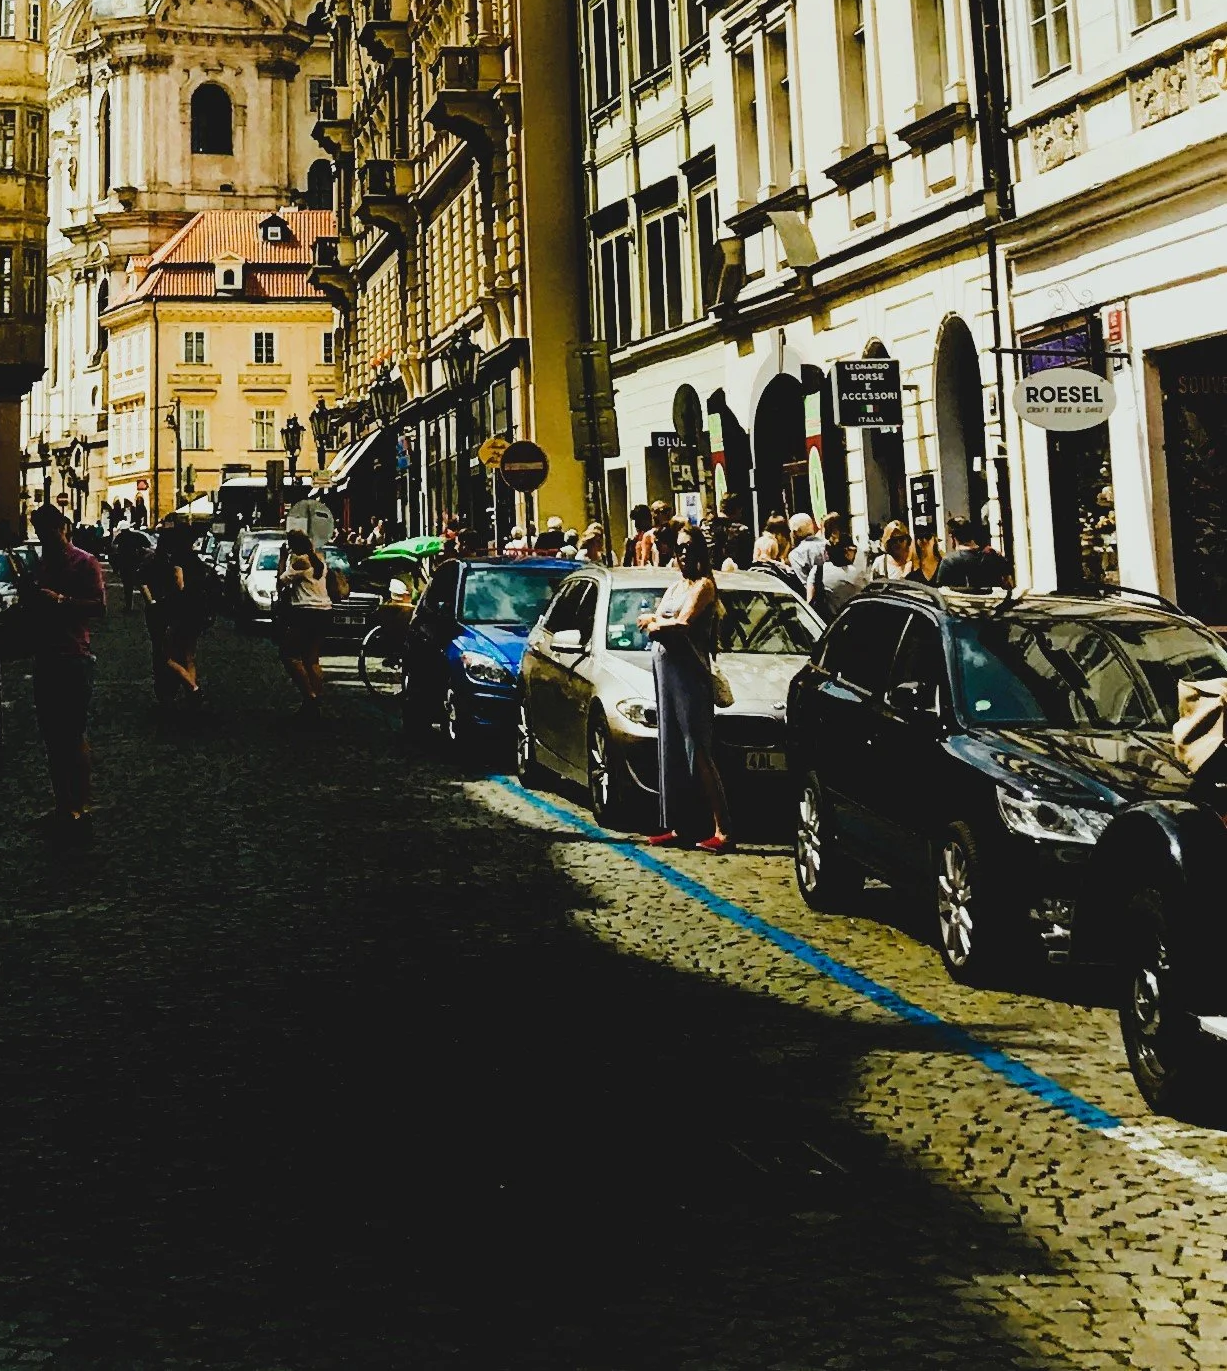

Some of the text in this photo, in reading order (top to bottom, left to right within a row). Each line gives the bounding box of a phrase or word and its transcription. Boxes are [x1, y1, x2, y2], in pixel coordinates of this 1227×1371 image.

[844, 362, 890, 371] LEONARDO
[850, 372, 885, 381] BORSE
[864, 382, 872, 391] E
[841, 391, 898, 401] ACCESSORI
[1025, 386, 1104, 403] ROESEL
